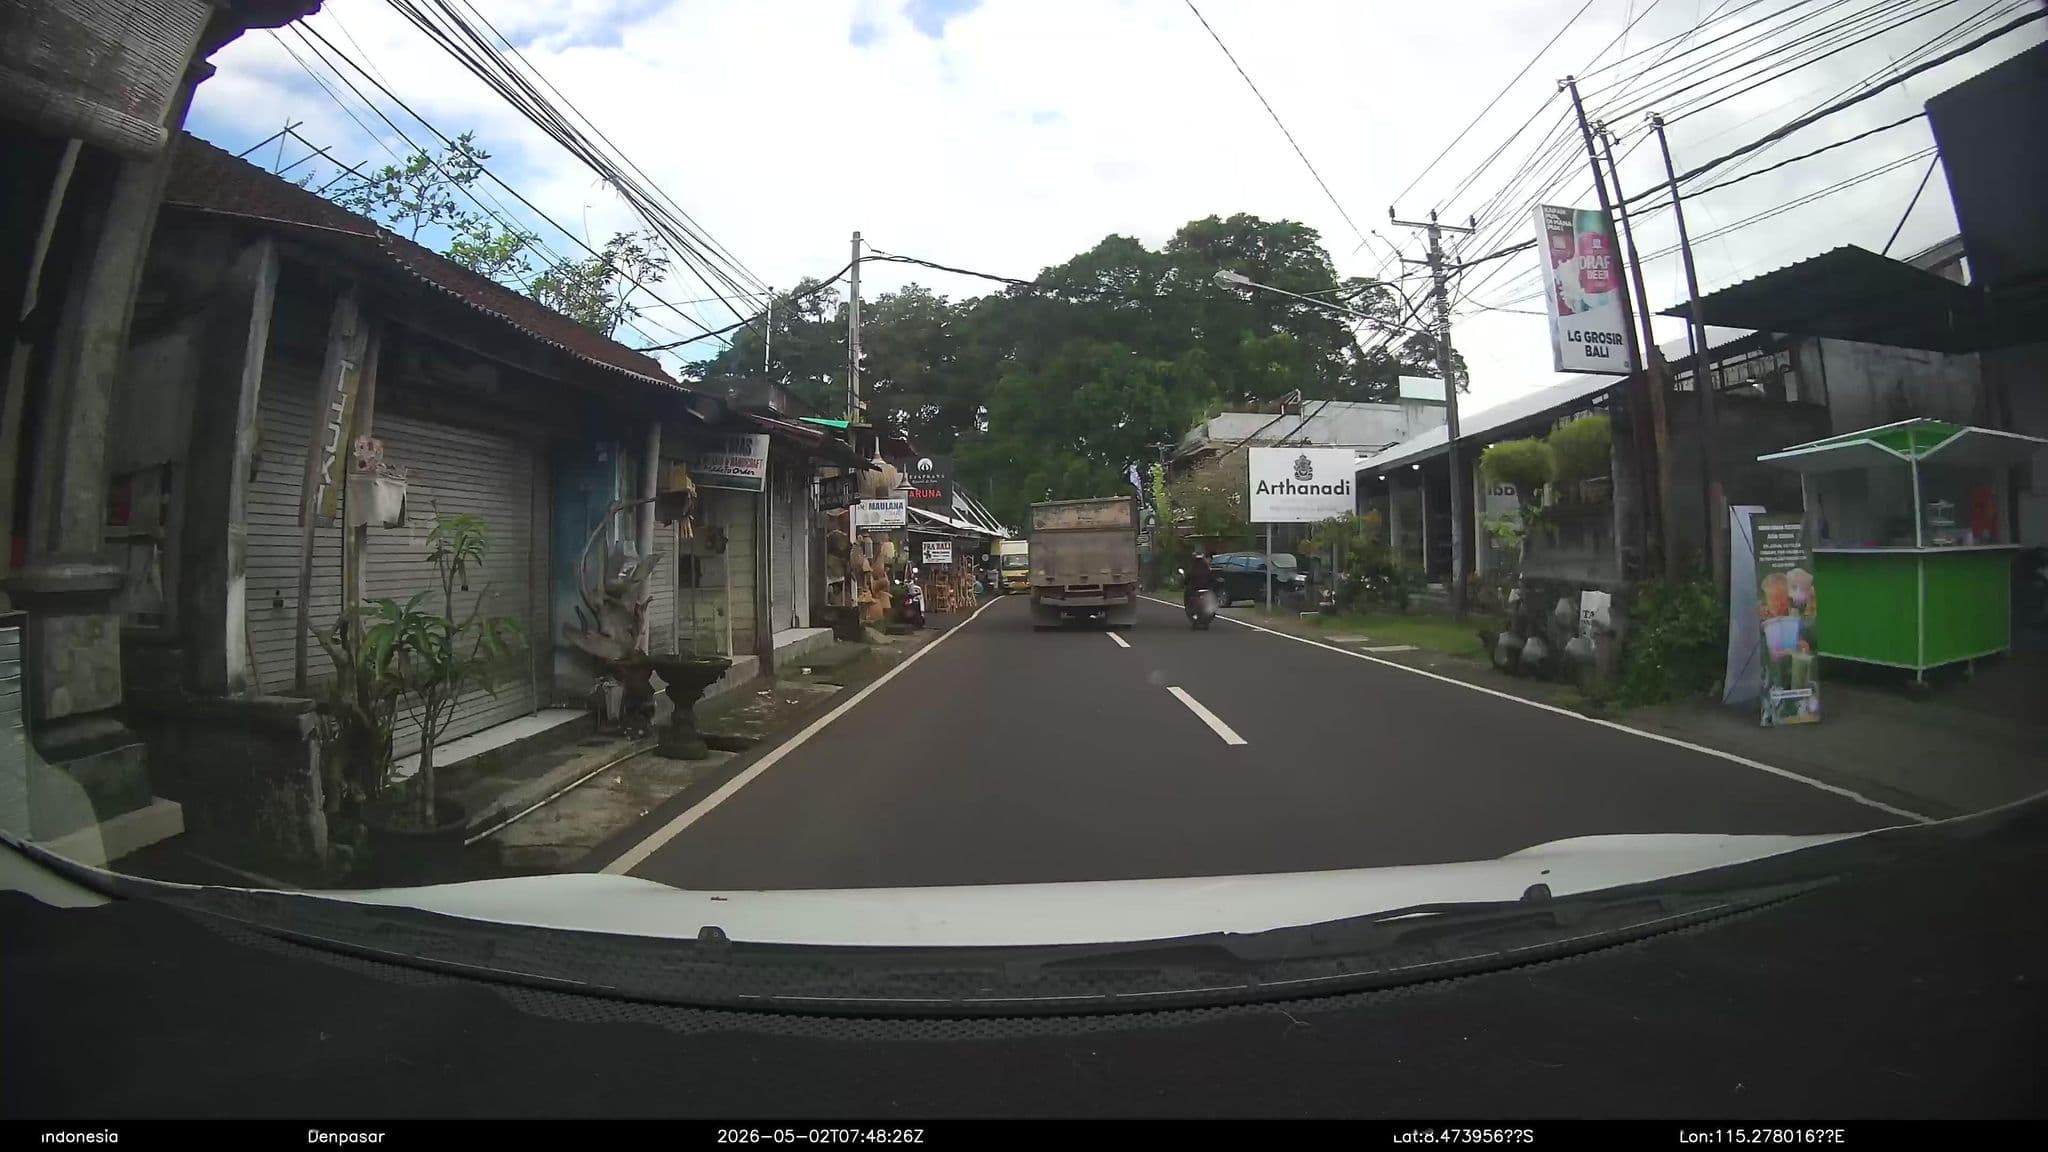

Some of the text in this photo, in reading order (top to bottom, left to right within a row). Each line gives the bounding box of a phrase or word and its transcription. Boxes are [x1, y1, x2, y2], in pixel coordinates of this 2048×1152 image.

[1567, 329, 1623, 346] LG GROSIR
[1585, 344, 1610, 359] BALI
[909, 489, 942, 498] ARUNA
[1256, 479, 1350, 496] Arthanadi
[868, 501, 904, 511] MAULANA
